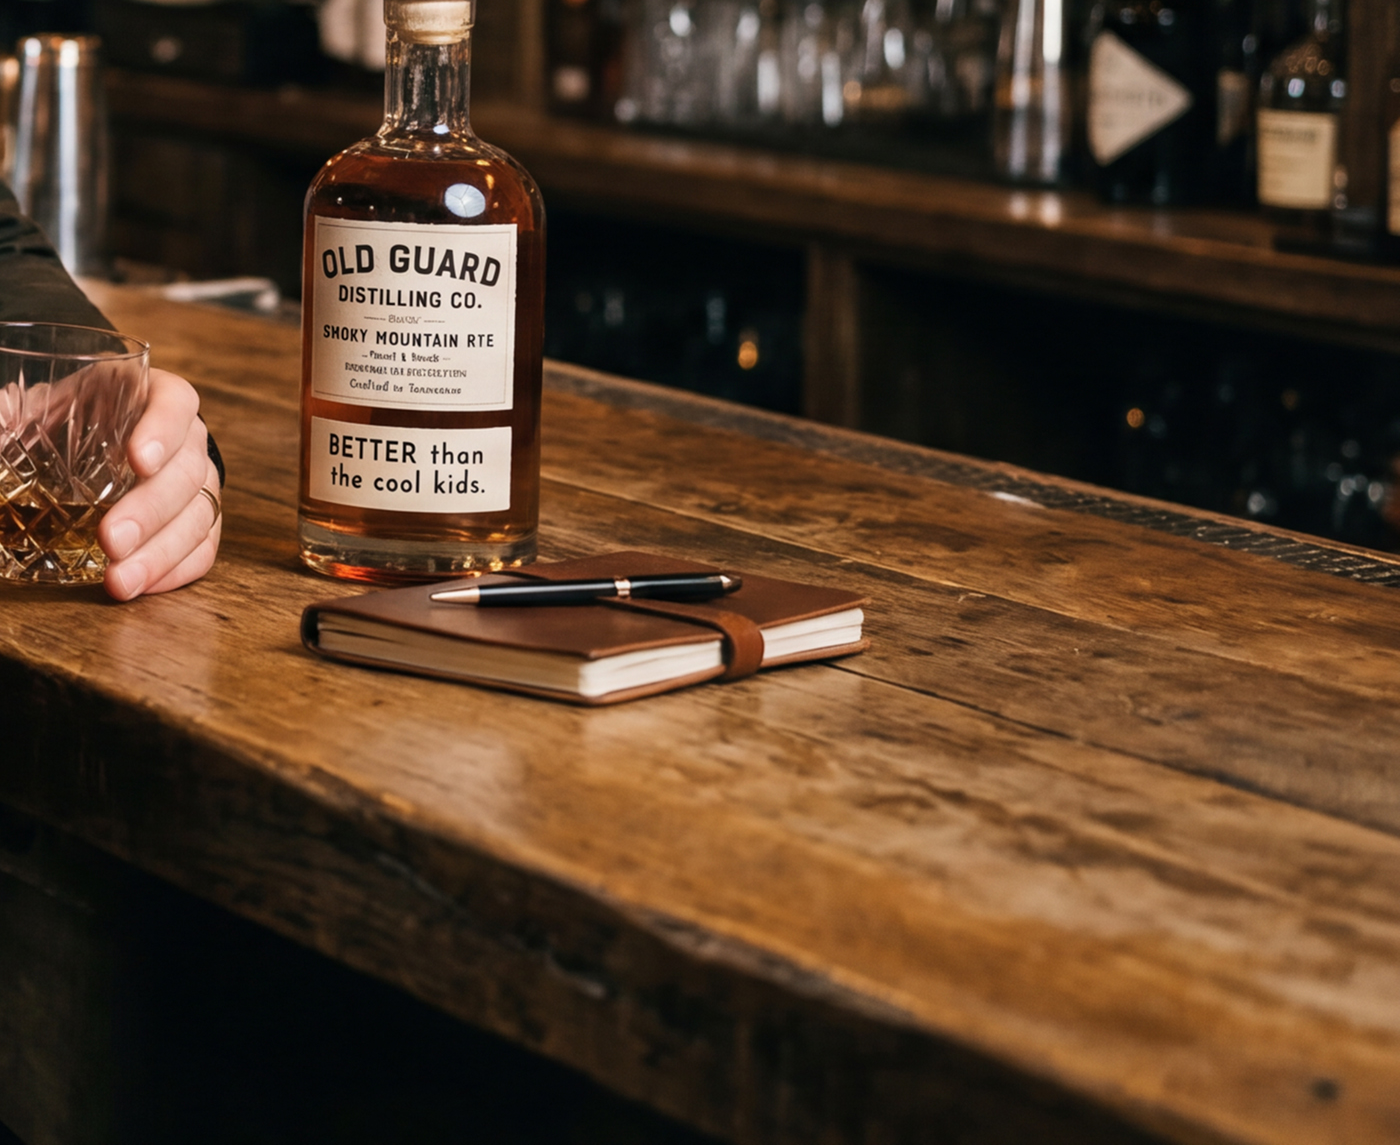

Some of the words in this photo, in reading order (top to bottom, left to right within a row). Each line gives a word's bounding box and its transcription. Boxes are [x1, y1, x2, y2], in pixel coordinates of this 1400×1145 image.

[322, 245, 374, 279] OLD
[390, 245, 500, 286] GUARD
[338, 284, 440, 307] DISTILLING
[451, 292, 481, 308] CO.
[376, 331, 458, 347] MOUNTAIN
[329, 433, 416, 463] BETTER
[431, 442, 482, 464] than
[331, 463, 362, 488] the
[374, 470, 419, 493] cool
[434, 469, 484, 493] kids.
